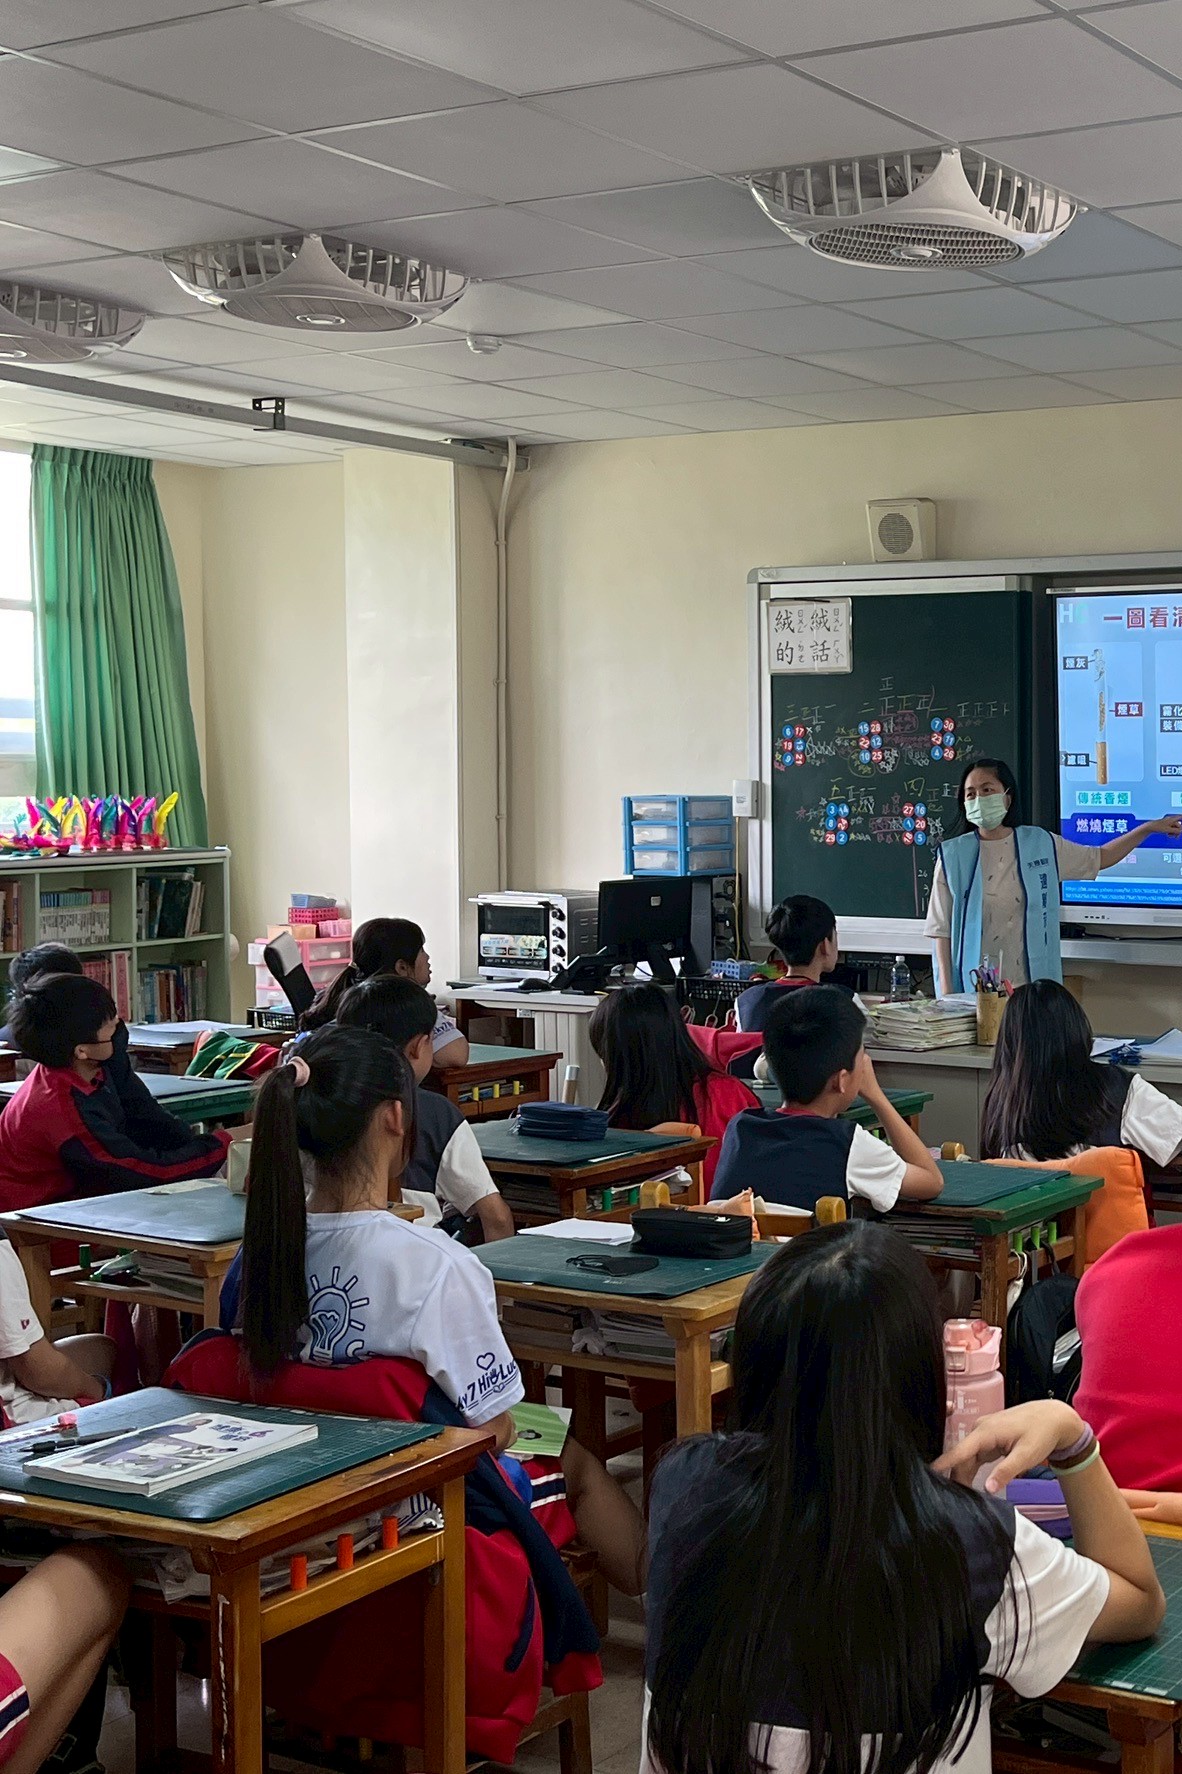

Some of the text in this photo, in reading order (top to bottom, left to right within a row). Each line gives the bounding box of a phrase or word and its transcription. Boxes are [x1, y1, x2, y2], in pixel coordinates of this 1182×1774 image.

[1117, 704, 1140, 715] 煙草
[1077, 792, 1129, 805] 傳統香煙
[1076, 818, 1128, 833] 燃燒煙草
